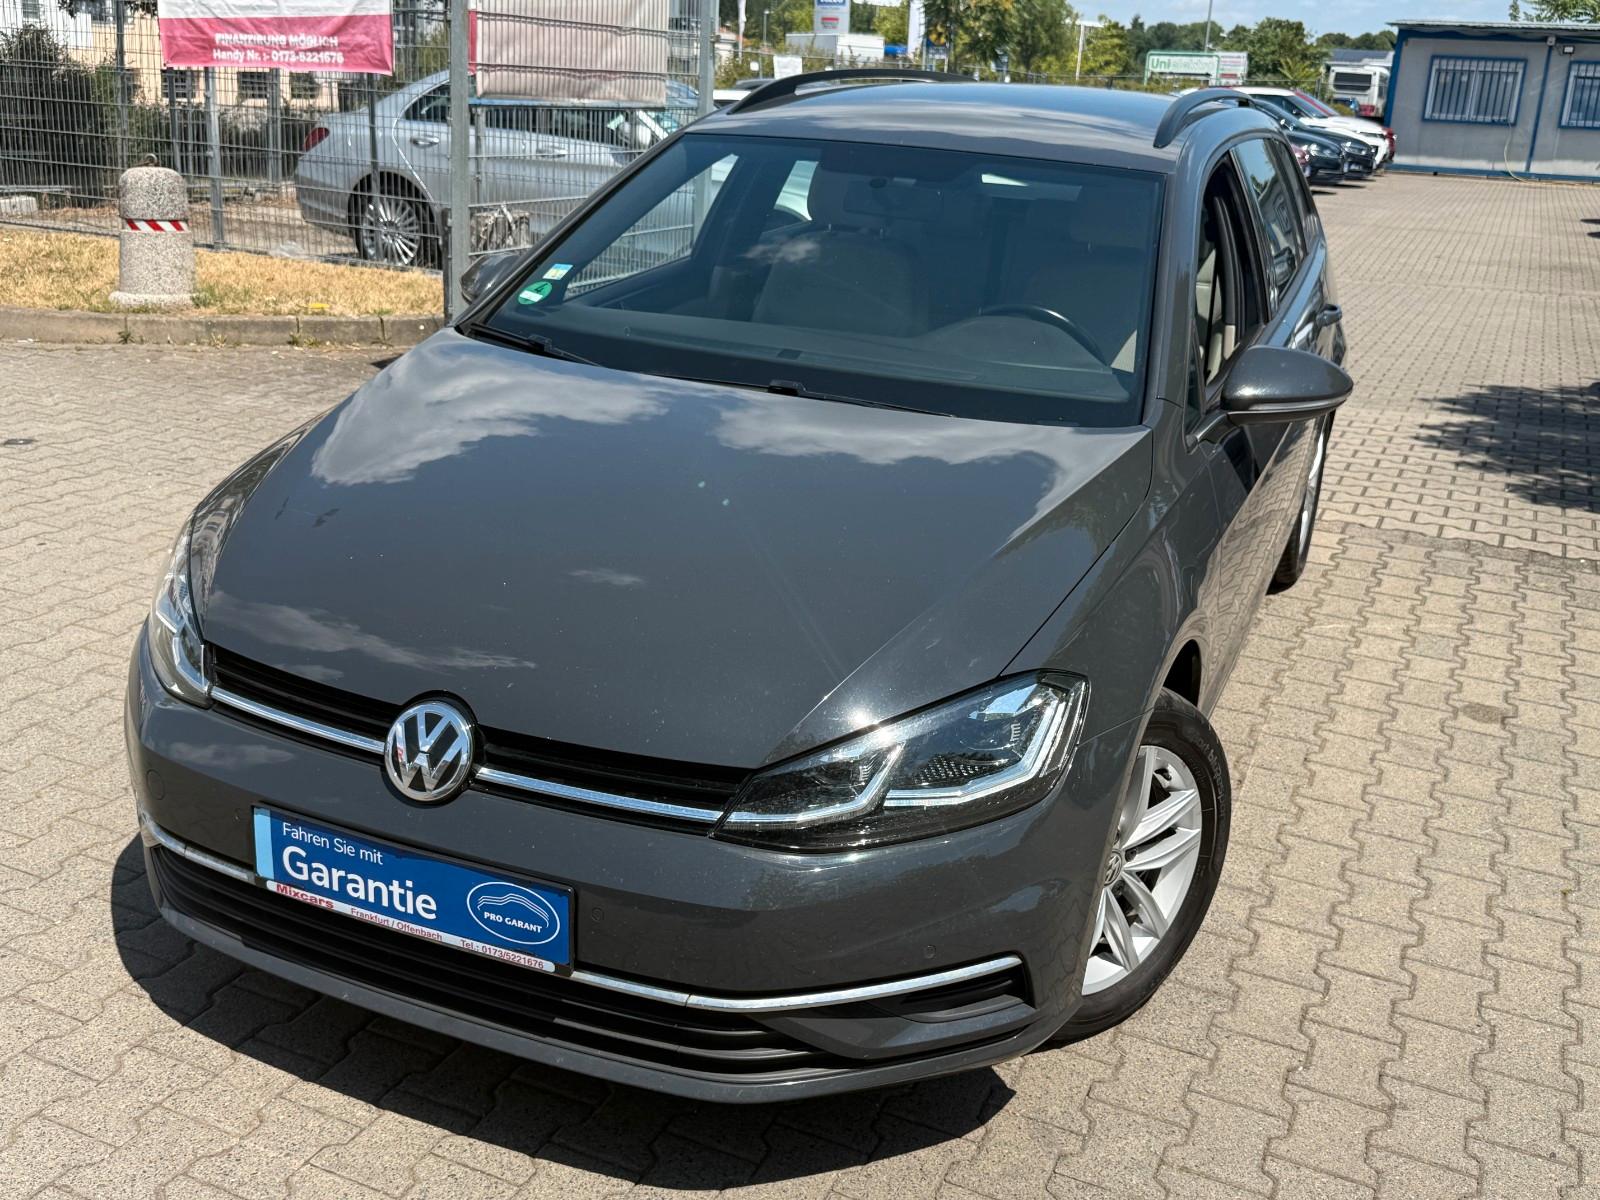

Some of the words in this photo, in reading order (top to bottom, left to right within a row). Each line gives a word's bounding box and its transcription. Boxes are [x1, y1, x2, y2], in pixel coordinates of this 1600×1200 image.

[213, 48, 244, 62] Handy
[246, 50, 260, 61] Nr.
[288, 34, 339, 47] MÖGLICH
[282, 822, 329, 849] Fahren
[333, 838, 356, 857] Sie
[359, 848, 384, 866] mit
[282, 845, 438, 921] Garantie
[276, 883, 335, 910] Mixcars
[350, 907, 390, 926] Frankfurt
[397, 921, 443, 942] Offenbach
[461, 939, 480, 952] Tel.:
[482, 945, 544, 970] 0173/5221676
[483, 911, 503, 923] PRO
[505, 917, 543, 933] GARANT
